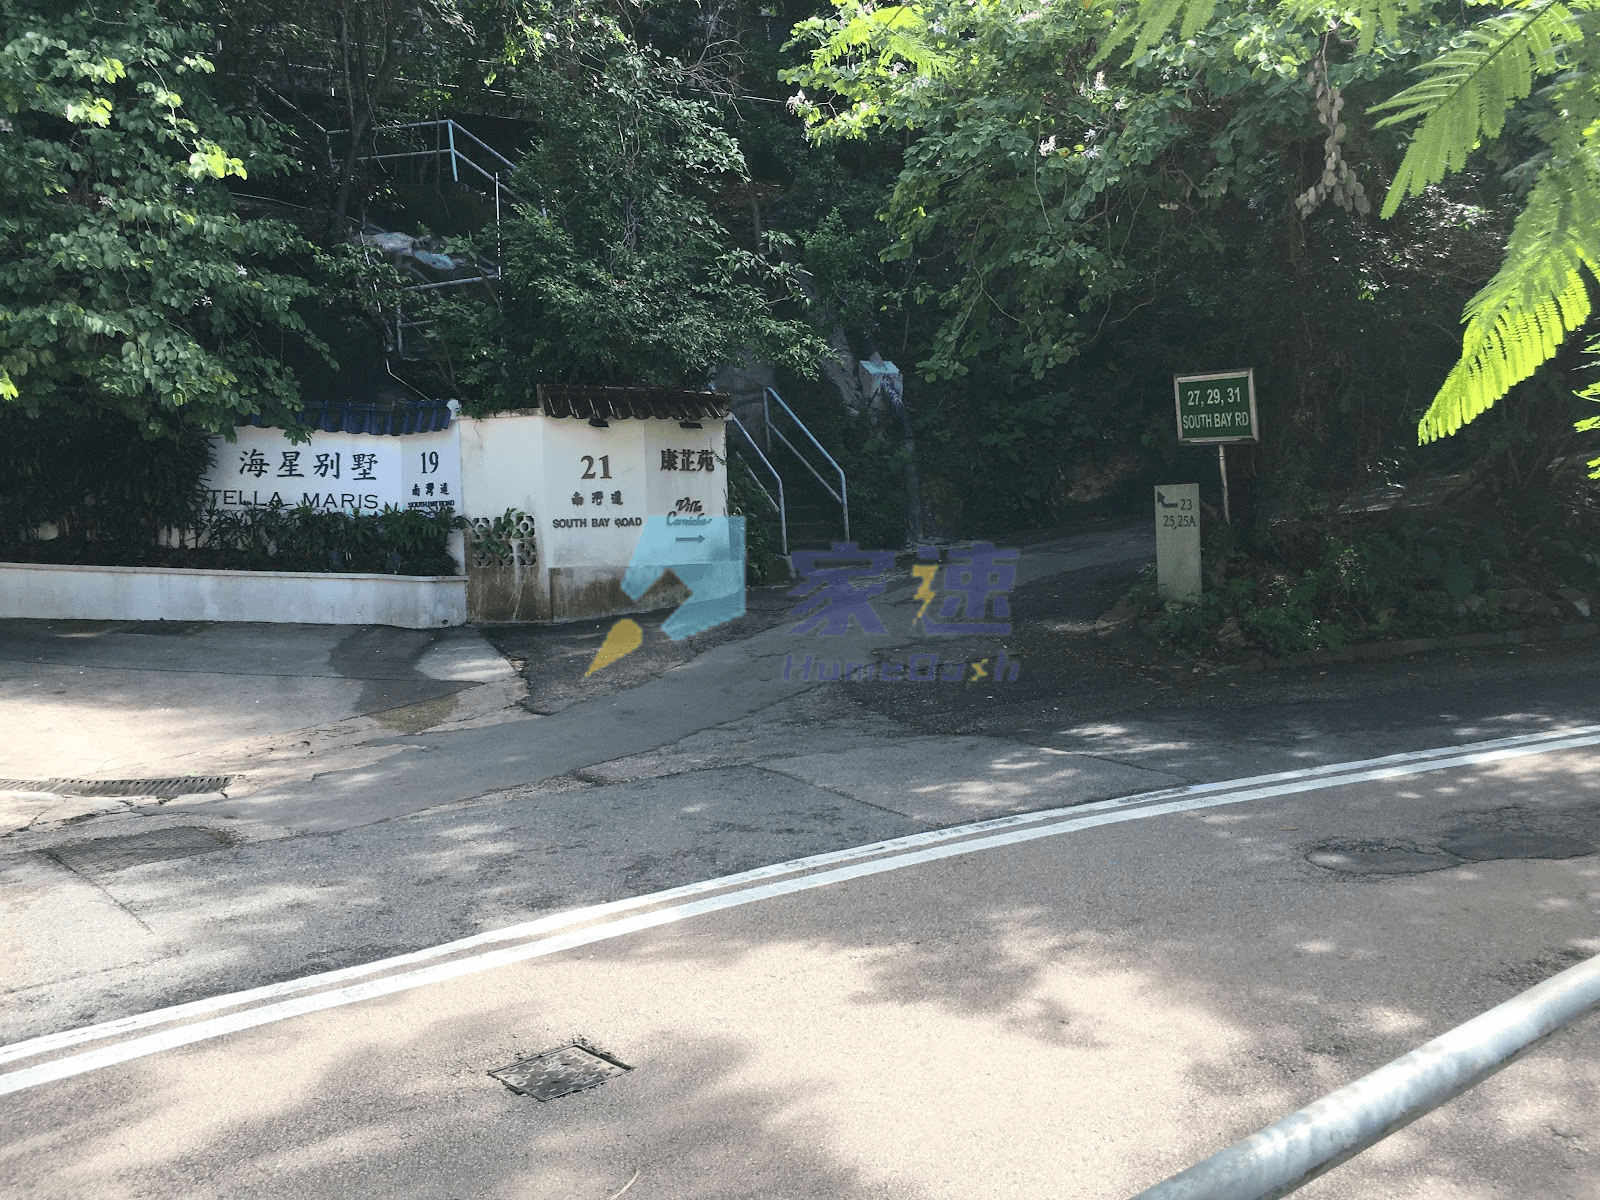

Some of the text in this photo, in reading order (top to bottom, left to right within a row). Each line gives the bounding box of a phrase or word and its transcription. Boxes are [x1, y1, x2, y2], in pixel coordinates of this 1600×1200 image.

[1187, 386, 1241, 407] 27, 29, 31
[1182, 411, 1249, 429] SOUTH BAY RD
[238, 448, 379, 481] 海星别墅
[420, 451, 439, 474] 19
[580, 455, 612, 480] 21
[660, 448, 715, 472] 康芷苑
[198, 489, 379, 510] TELLA MARIS
[675, 497, 703, 512] Villa
[1180, 499, 1193, 510] 23
[552, 517, 643, 528] SOUTH BAY ROAD
[1163, 515, 1197, 529] 25,25A
